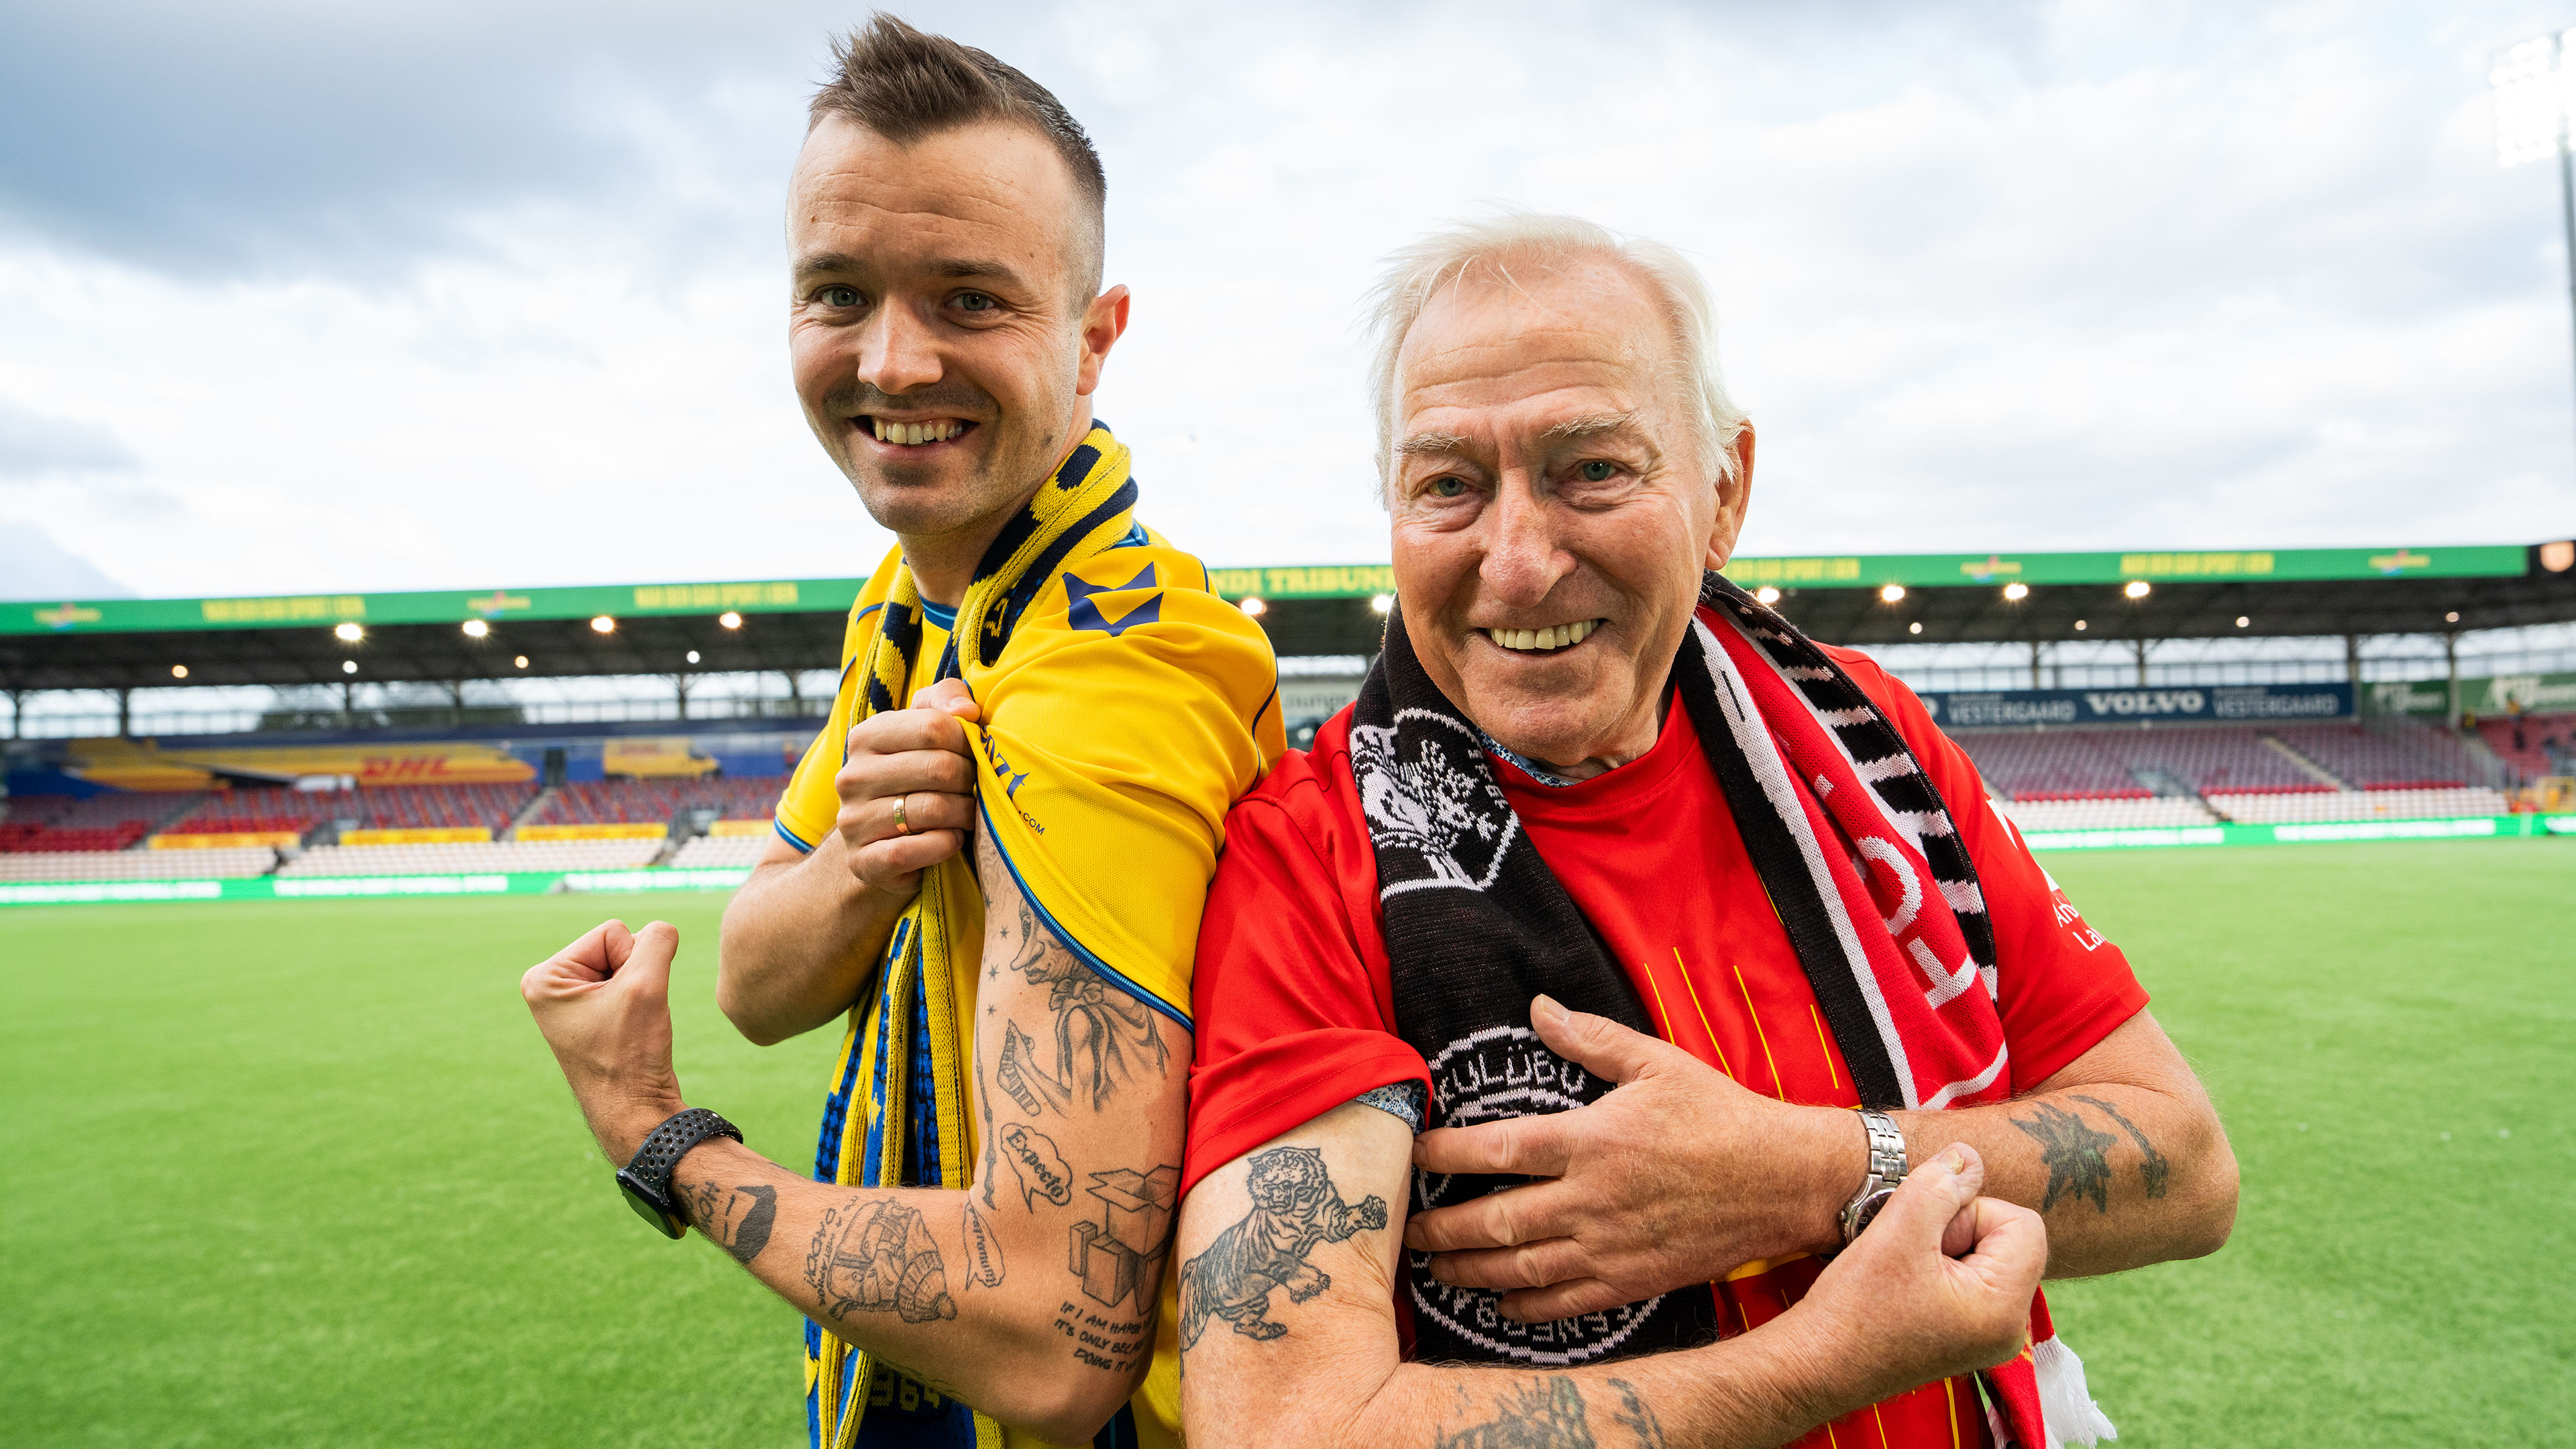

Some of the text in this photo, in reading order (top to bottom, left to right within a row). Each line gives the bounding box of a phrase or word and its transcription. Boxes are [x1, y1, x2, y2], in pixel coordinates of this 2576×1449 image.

[2085, 690, 2206, 715] VOLVO
[363, 755, 454, 778] DHL
[1006, 1128, 1064, 1198] Expecto
[1060, 1300, 1075, 1314] IF
[1075, 1308, 1084, 1320] I
[1085, 1315, 1108, 1331] AM
[1079, 1330, 1111, 1350] ONLY
[1073, 1347, 1113, 1370] DOING
